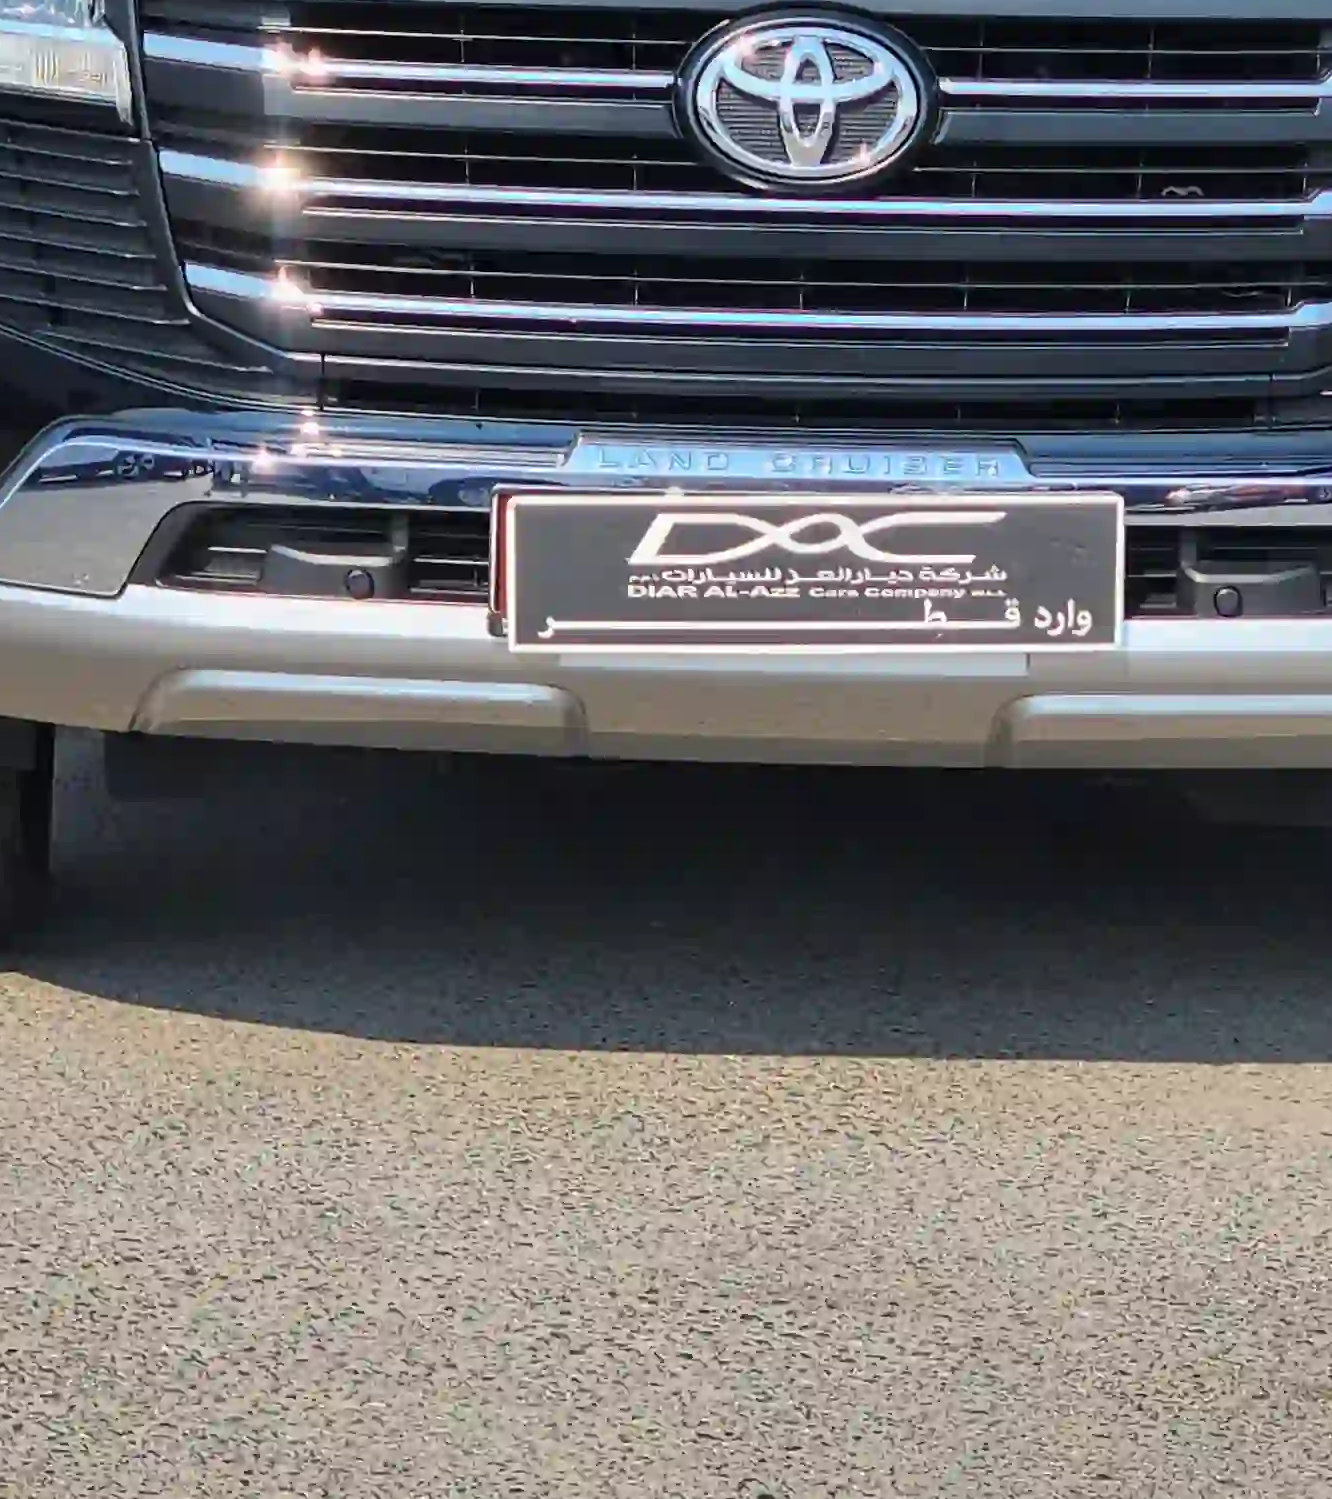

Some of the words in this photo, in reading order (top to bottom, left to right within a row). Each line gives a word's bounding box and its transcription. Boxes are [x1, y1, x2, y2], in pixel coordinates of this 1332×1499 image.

[598, 448, 730, 472] LAND
[771, 451, 1000, 477] CRUISER
[918, 564, 1008, 585] شركة
[627, 585, 699, 598] DIAR
[808, 587, 859, 598] Cars
[864, 587, 967, 600] Company
[1034, 601, 1093, 636] وارد
